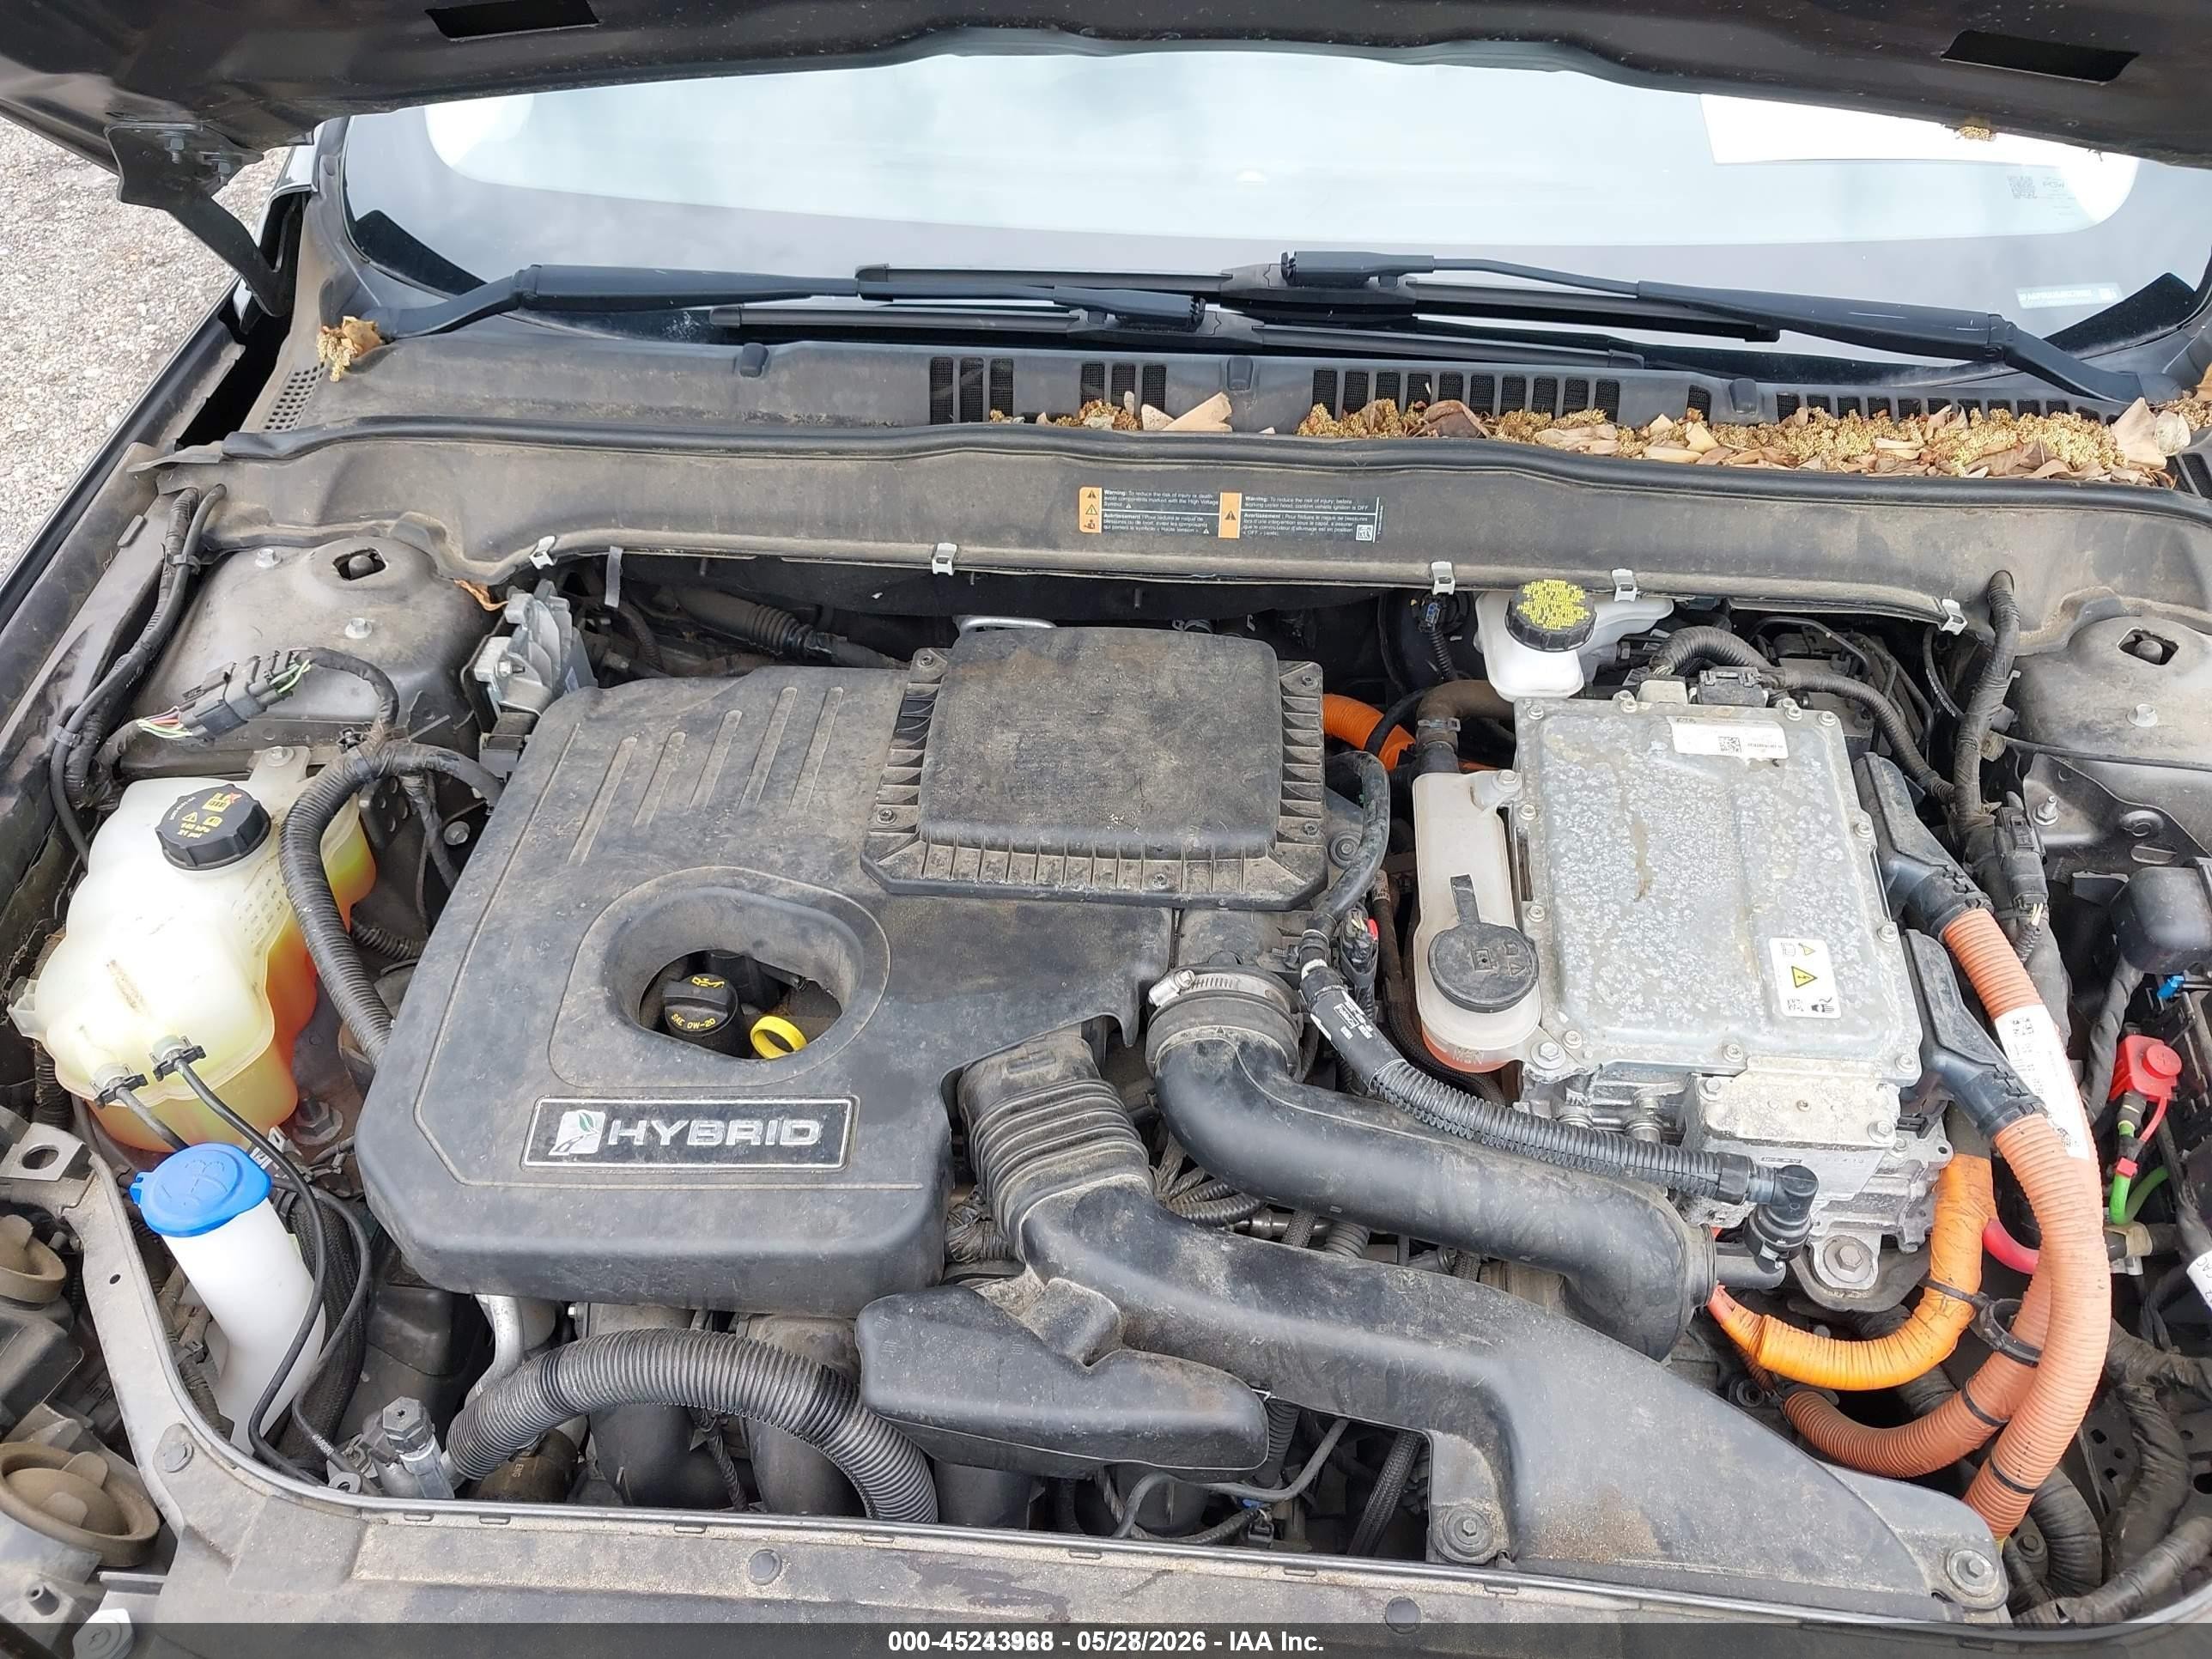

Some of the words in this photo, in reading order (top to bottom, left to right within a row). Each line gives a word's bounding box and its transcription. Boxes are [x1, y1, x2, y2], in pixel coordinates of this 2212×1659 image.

[671, 1013, 686, 1027] SAE
[687, 1018, 716, 1030] 0W-20
[607, 1119, 822, 1146] HYBRID
